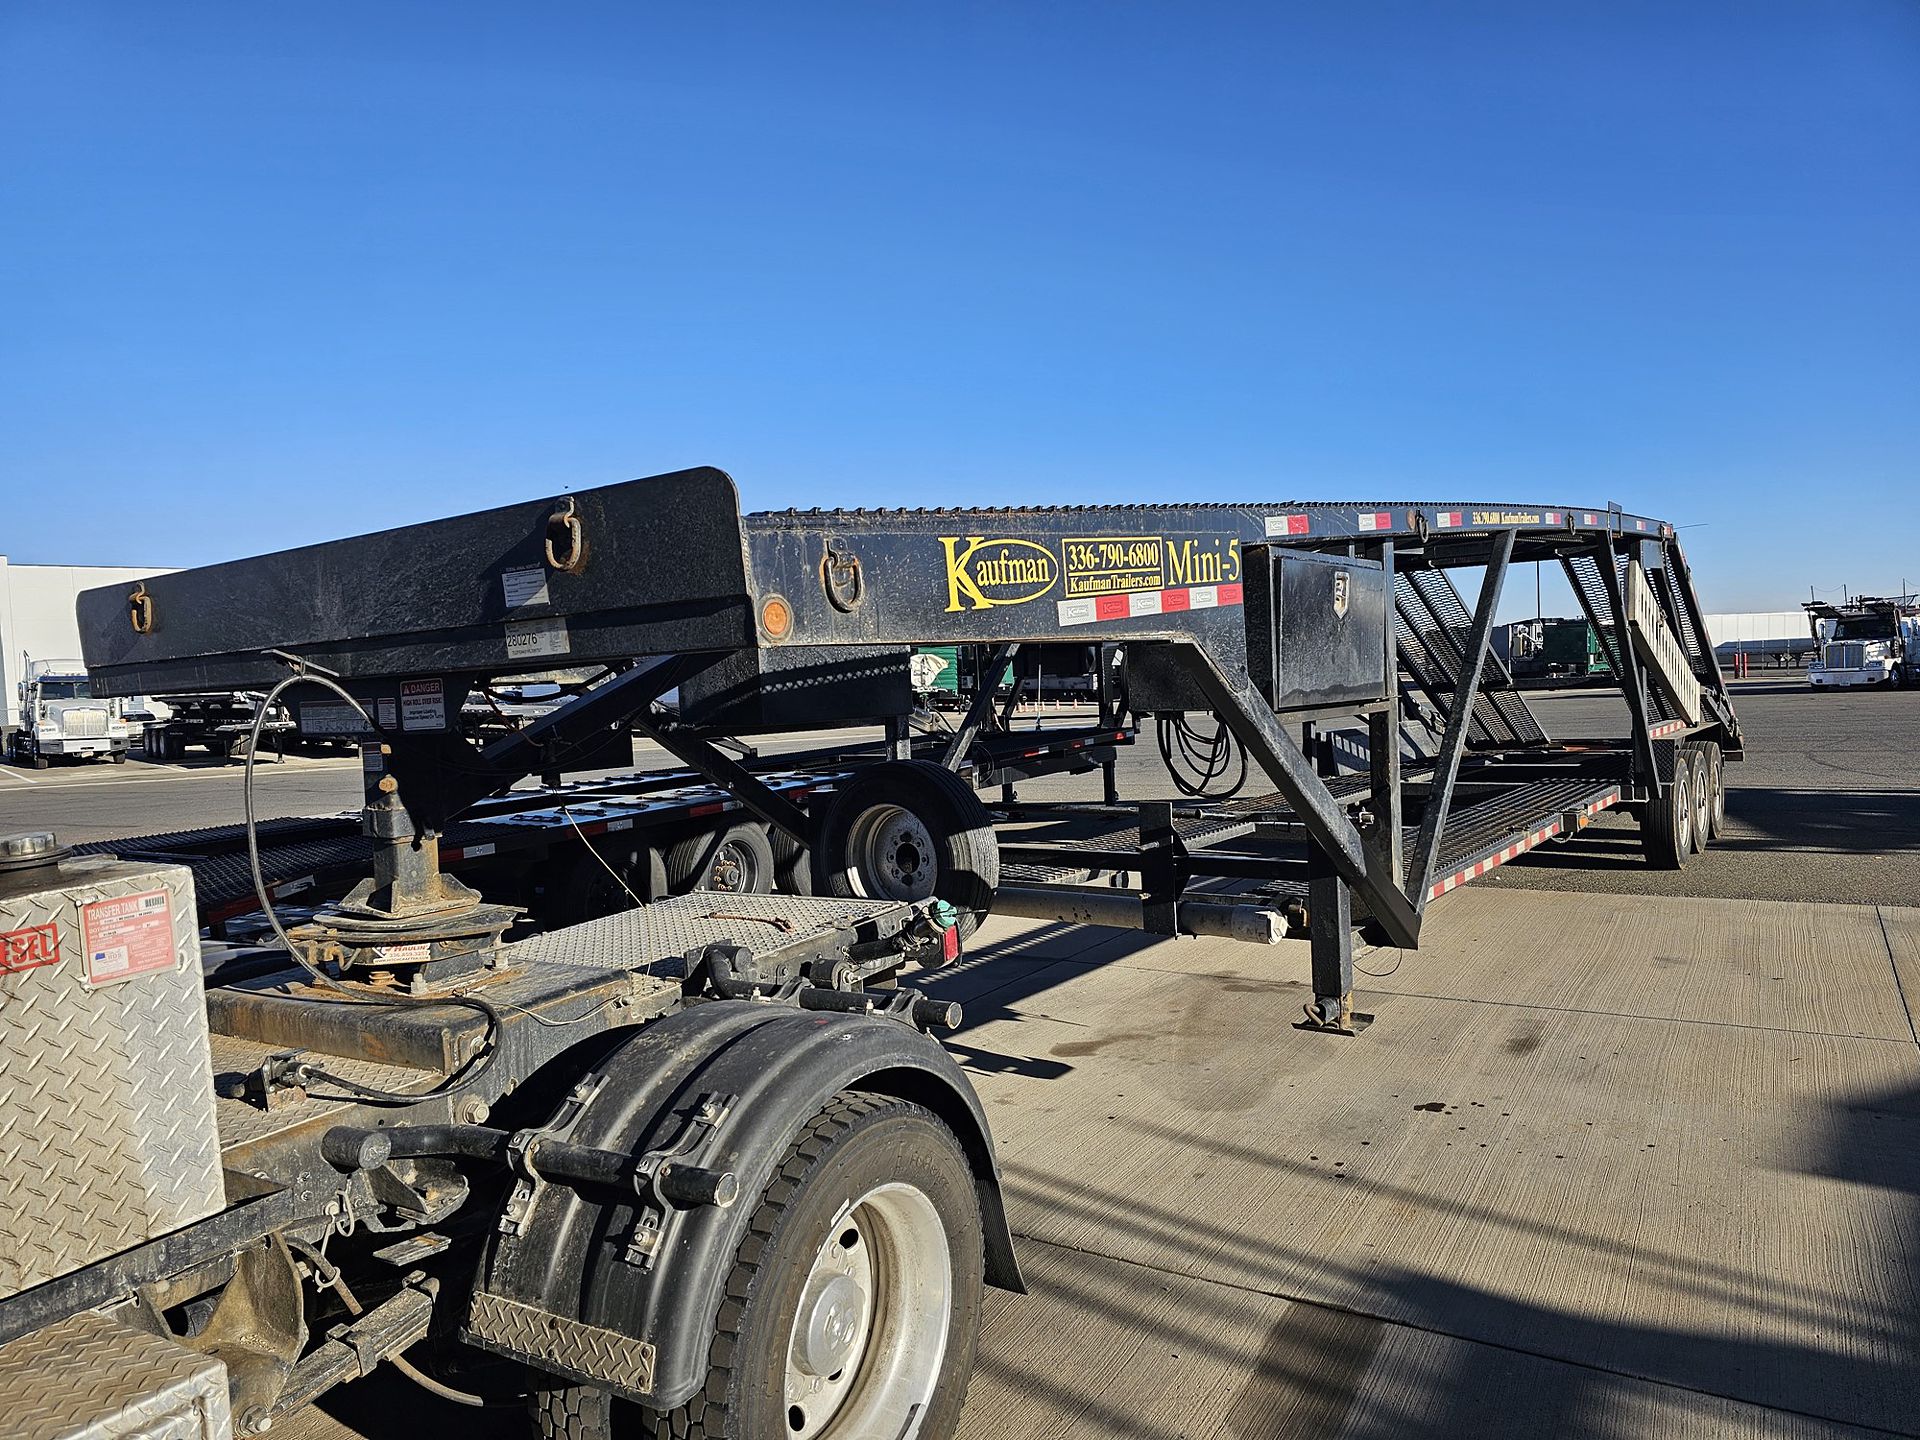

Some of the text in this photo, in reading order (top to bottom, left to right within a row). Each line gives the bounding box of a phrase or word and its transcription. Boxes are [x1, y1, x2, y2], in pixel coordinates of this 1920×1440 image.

[1068, 542, 1159, 571] 336-790-6800
[1166, 538, 1241, 586] Mini-5
[938, 537, 1050, 613] Kaufman
[1070, 574, 1161, 593] KaufmanTrailers.com
[507, 632, 538, 647] 280276
[410, 682, 440, 693] DANGER
[87, 904, 121, 921] TRANSFER
[121, 900, 138, 914] TANK
[0, 932, 51, 966] ESEL
